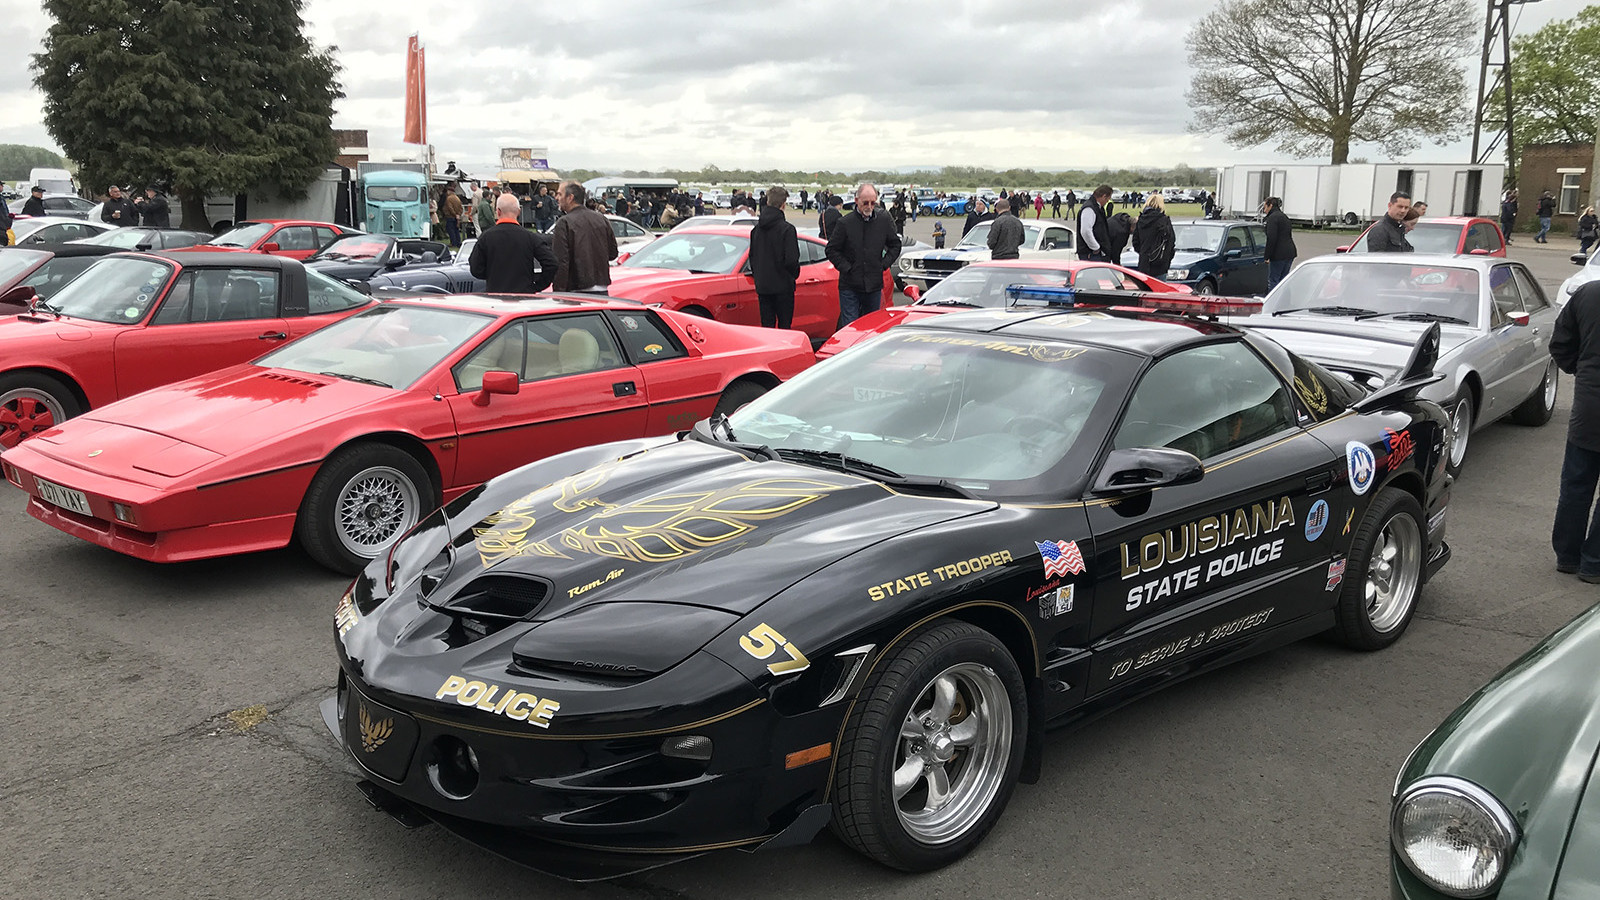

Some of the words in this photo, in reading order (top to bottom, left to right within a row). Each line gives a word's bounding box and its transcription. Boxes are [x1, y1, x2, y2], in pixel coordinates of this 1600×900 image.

[502, 156, 531, 168] Waffles
[315, 294, 329, 307] 38
[60, 488, 84, 511] YAY
[1120, 496, 1295, 580] LOUISIANA
[567, 579, 605, 598] Ram
[605, 568, 625, 582] Air
[867, 571, 932, 601] STATE
[933, 549, 1013, 582] TROOPER
[1125, 566, 1201, 611] STATE
[1205, 538, 1284, 583] POLICE
[1026, 579, 1060, 602] Louisiana
[1056, 601, 1072, 614] LSU
[739, 622, 810, 676] 57
[1109, 661, 1133, 681] TO
[1134, 637, 1190, 670] SERVE
[1206, 607, 1275, 643] PROTECT
[573, 660, 638, 671] PONTIAC
[435, 675, 560, 729] POLICE
